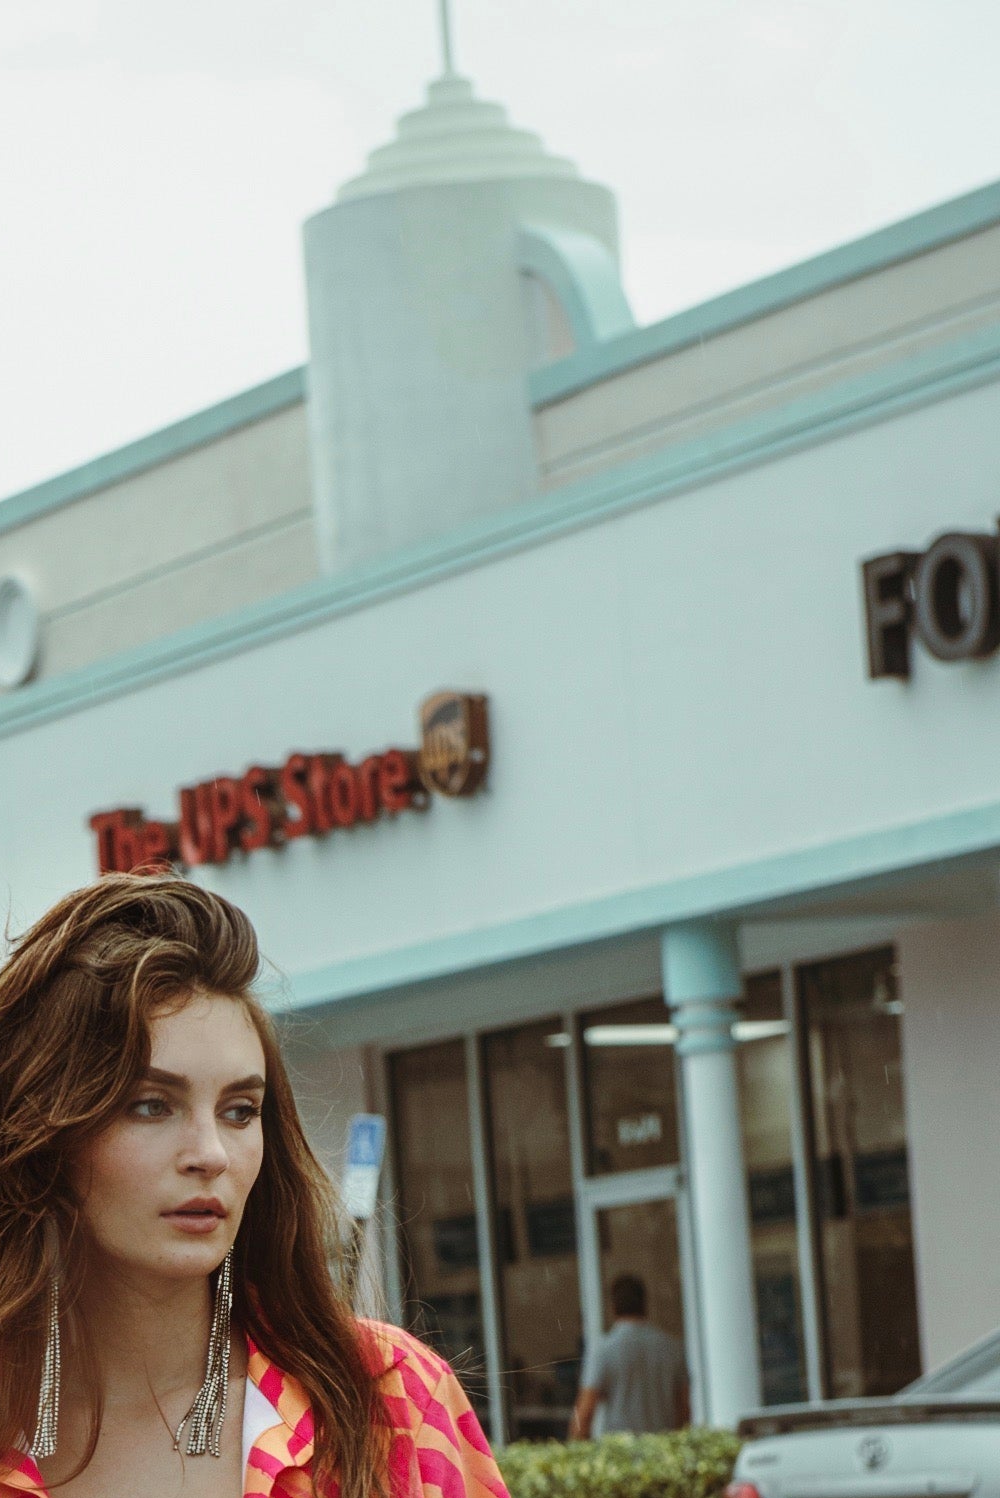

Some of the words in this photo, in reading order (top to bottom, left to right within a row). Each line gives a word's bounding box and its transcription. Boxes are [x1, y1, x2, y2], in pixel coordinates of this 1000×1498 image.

[862, 531, 1000, 680] FO
[88, 809, 173, 875] The
[179, 766, 273, 867] UPS
[282, 749, 413, 839] Store
